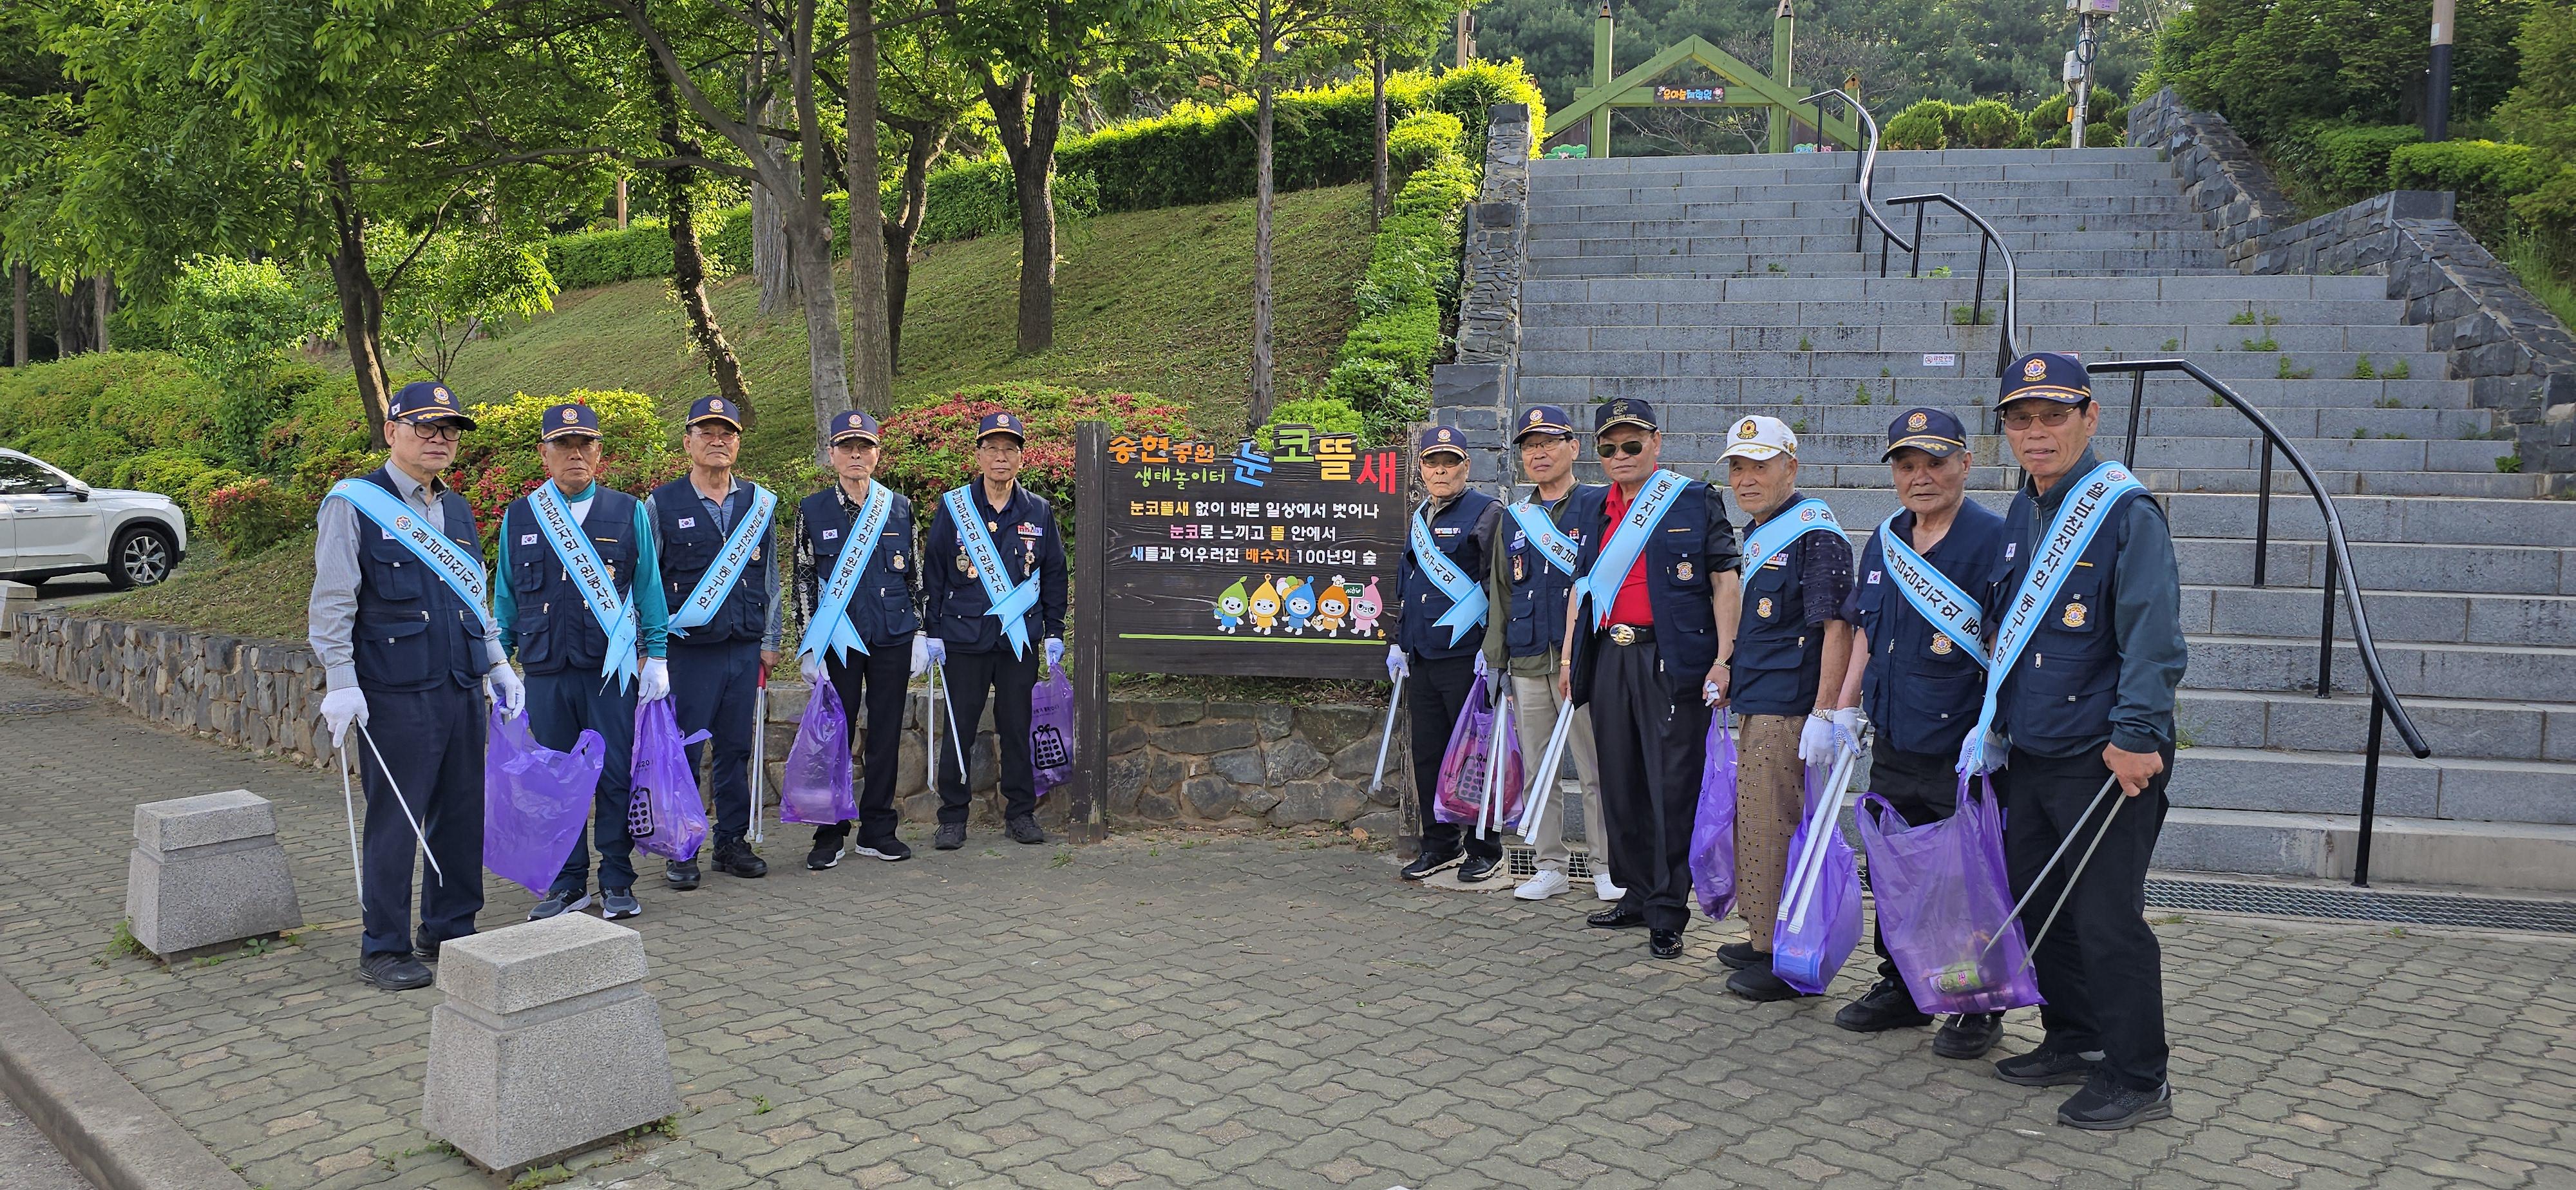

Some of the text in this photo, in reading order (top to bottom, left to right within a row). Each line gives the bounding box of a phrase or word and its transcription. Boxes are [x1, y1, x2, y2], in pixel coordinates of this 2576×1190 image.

[1109, 435, 1215, 464] 송현공원
[1233, 430, 1396, 495] 눈코뜰새
[1135, 466, 1225, 489] 생태놀이터
[1130, 500, 1379, 519] 눈코뜰새 없이 바쁜 일상에서 벗어나
[1632, 480, 1672, 528] 동구지회
[537, 488, 616, 611] 월남참전자회 자원봉사자
[831, 488, 886, 599] 월남참전자회 자원봉사자
[1130, 546, 1377, 565] 새들과 어우러진 배수지 100년의 숲
[1170, 524, 1336, 542] 눈코로 느끼고 뜰 안에서
[412, 527, 482, 597] 월남참전자회
[697, 507, 766, 610] 월남참전자회 동구지회
[974, 543, 1007, 593] 자원봉사자
[1423, 547, 1456, 584] 동구지회
[1887, 545, 1964, 621] 월남참전자회
[1996, 482, 2110, 666] 월남참전자회 동구지회
